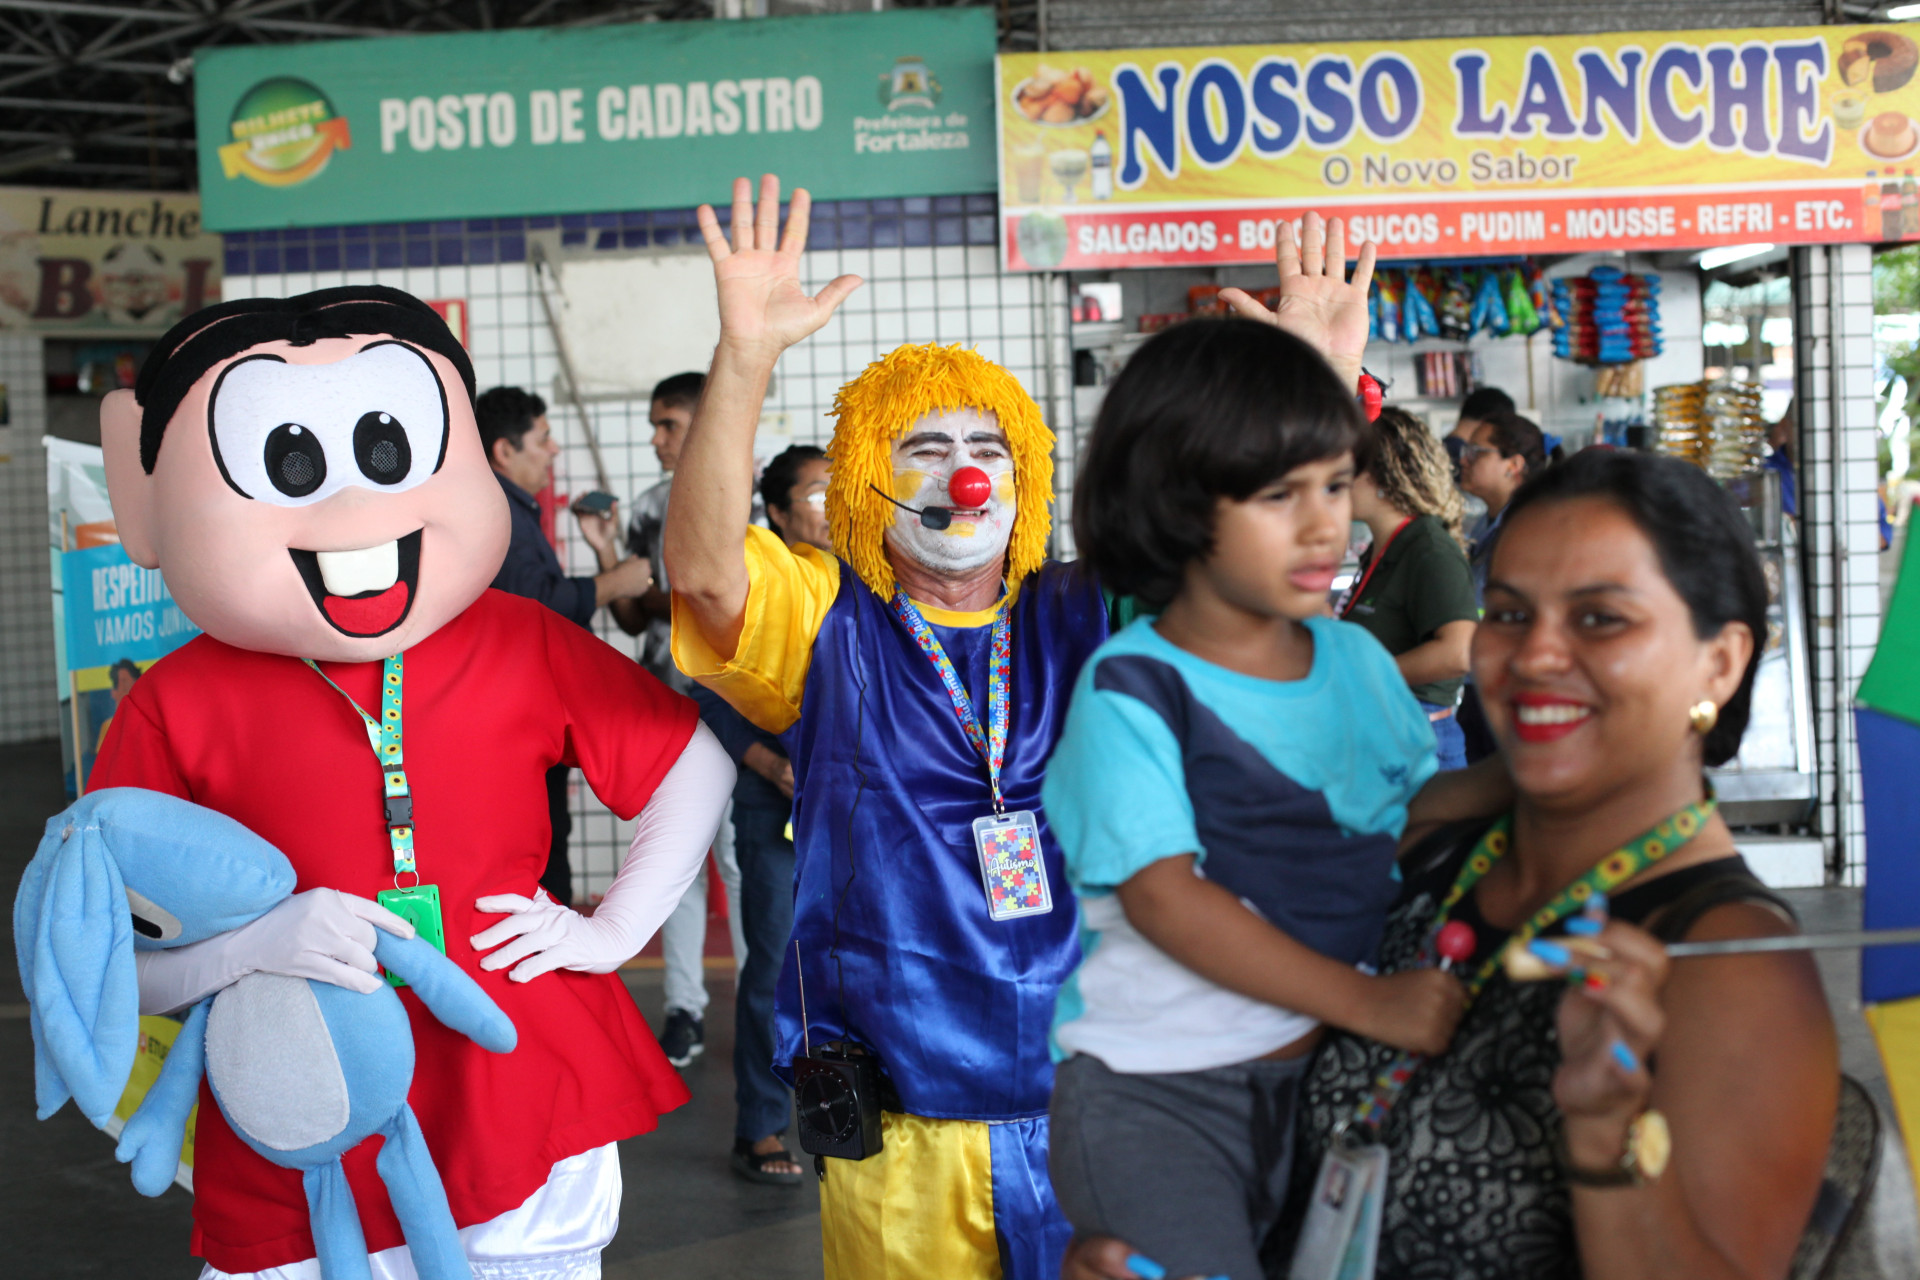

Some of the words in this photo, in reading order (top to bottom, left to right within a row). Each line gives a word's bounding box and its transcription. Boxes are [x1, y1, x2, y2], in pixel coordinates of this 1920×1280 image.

[380, 91, 516, 154] POSTO
[529, 88, 586, 145] DE
[597, 75, 823, 142] CADASTRO
[854, 114, 942, 132] Prefeitura
[945, 111, 968, 128] de
[1113, 53, 1424, 188] NOSSO
[1452, 39, 1832, 166] LANCHE
[855, 127, 970, 153] Fortaleza
[1323, 155, 1351, 186] O
[1364, 153, 1458, 185] Novo
[1470, 150, 1576, 181] Sabor
[1078, 220, 1217, 255] SALGADOS
[1238, 216, 1326, 250] BOO
[1349, 213, 1440, 246] SUCOS
[1461, 210, 1545, 241] PUDIM
[1566, 206, 1675, 239] MOUSSE
[1697, 202, 1774, 234] REFRI
[1795, 200, 1853, 231] ETC.
[94, 609, 155, 646] VAMOS
[990, 856, 1035, 878] Autismo
